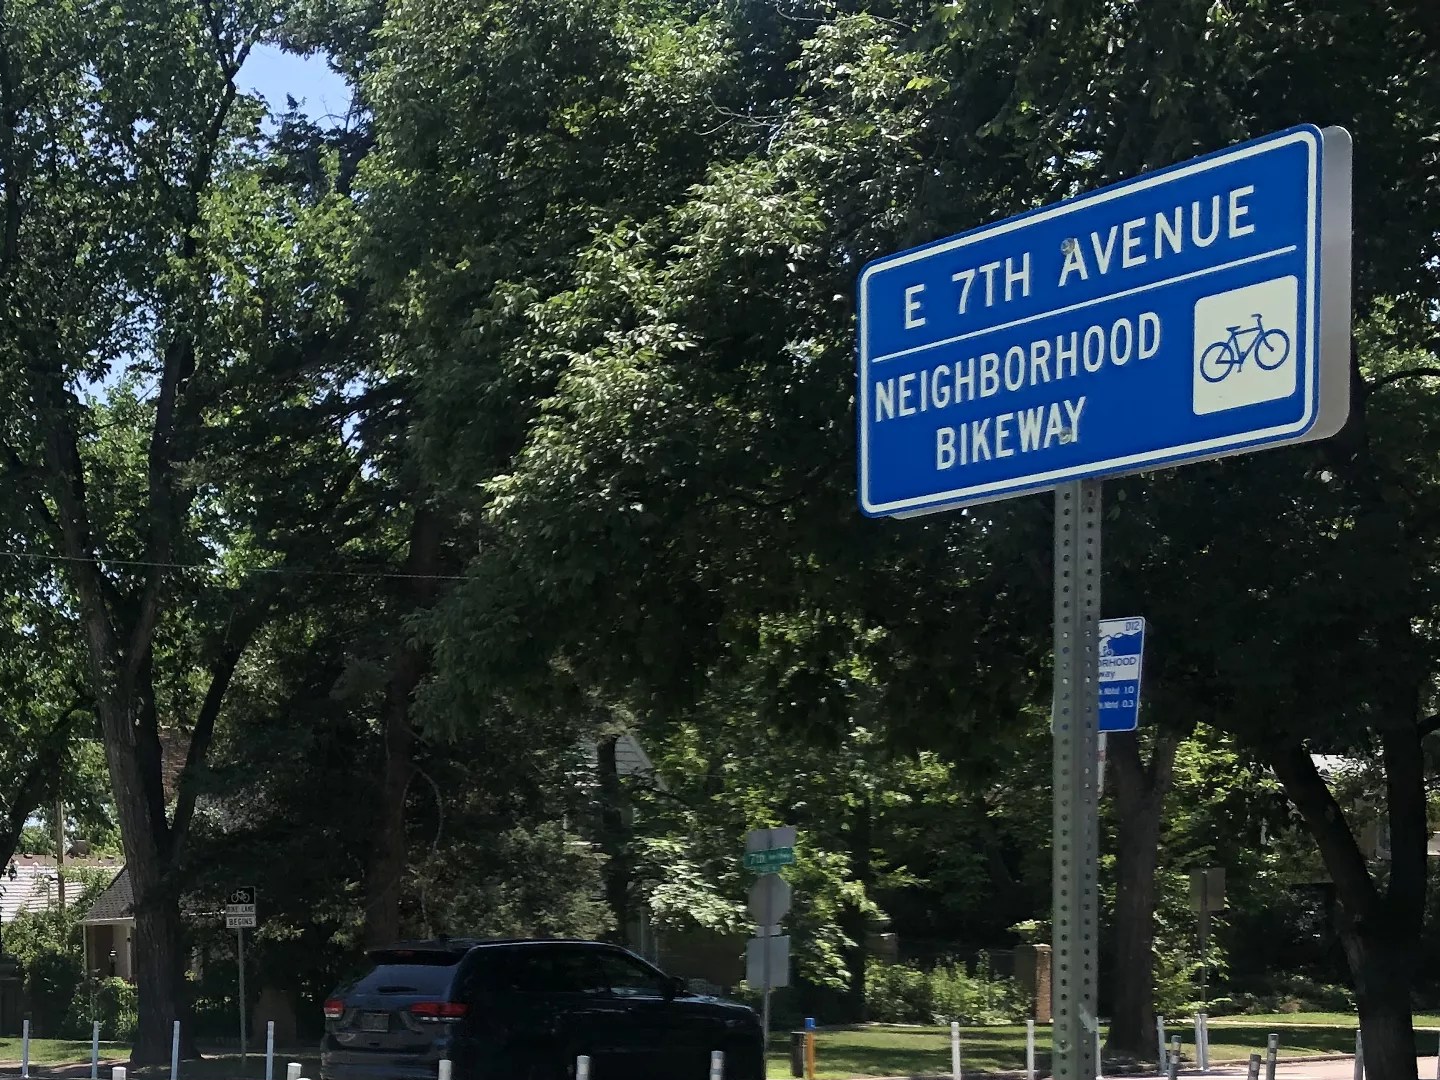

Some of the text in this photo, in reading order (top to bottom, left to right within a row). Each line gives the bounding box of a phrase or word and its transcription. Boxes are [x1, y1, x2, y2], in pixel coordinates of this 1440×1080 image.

[904, 184, 1256, 330] E 7TH AVENUE
[875, 311, 1161, 423] NEIGHBORHOOD
[936, 396, 1087, 471] BIKEWAY
